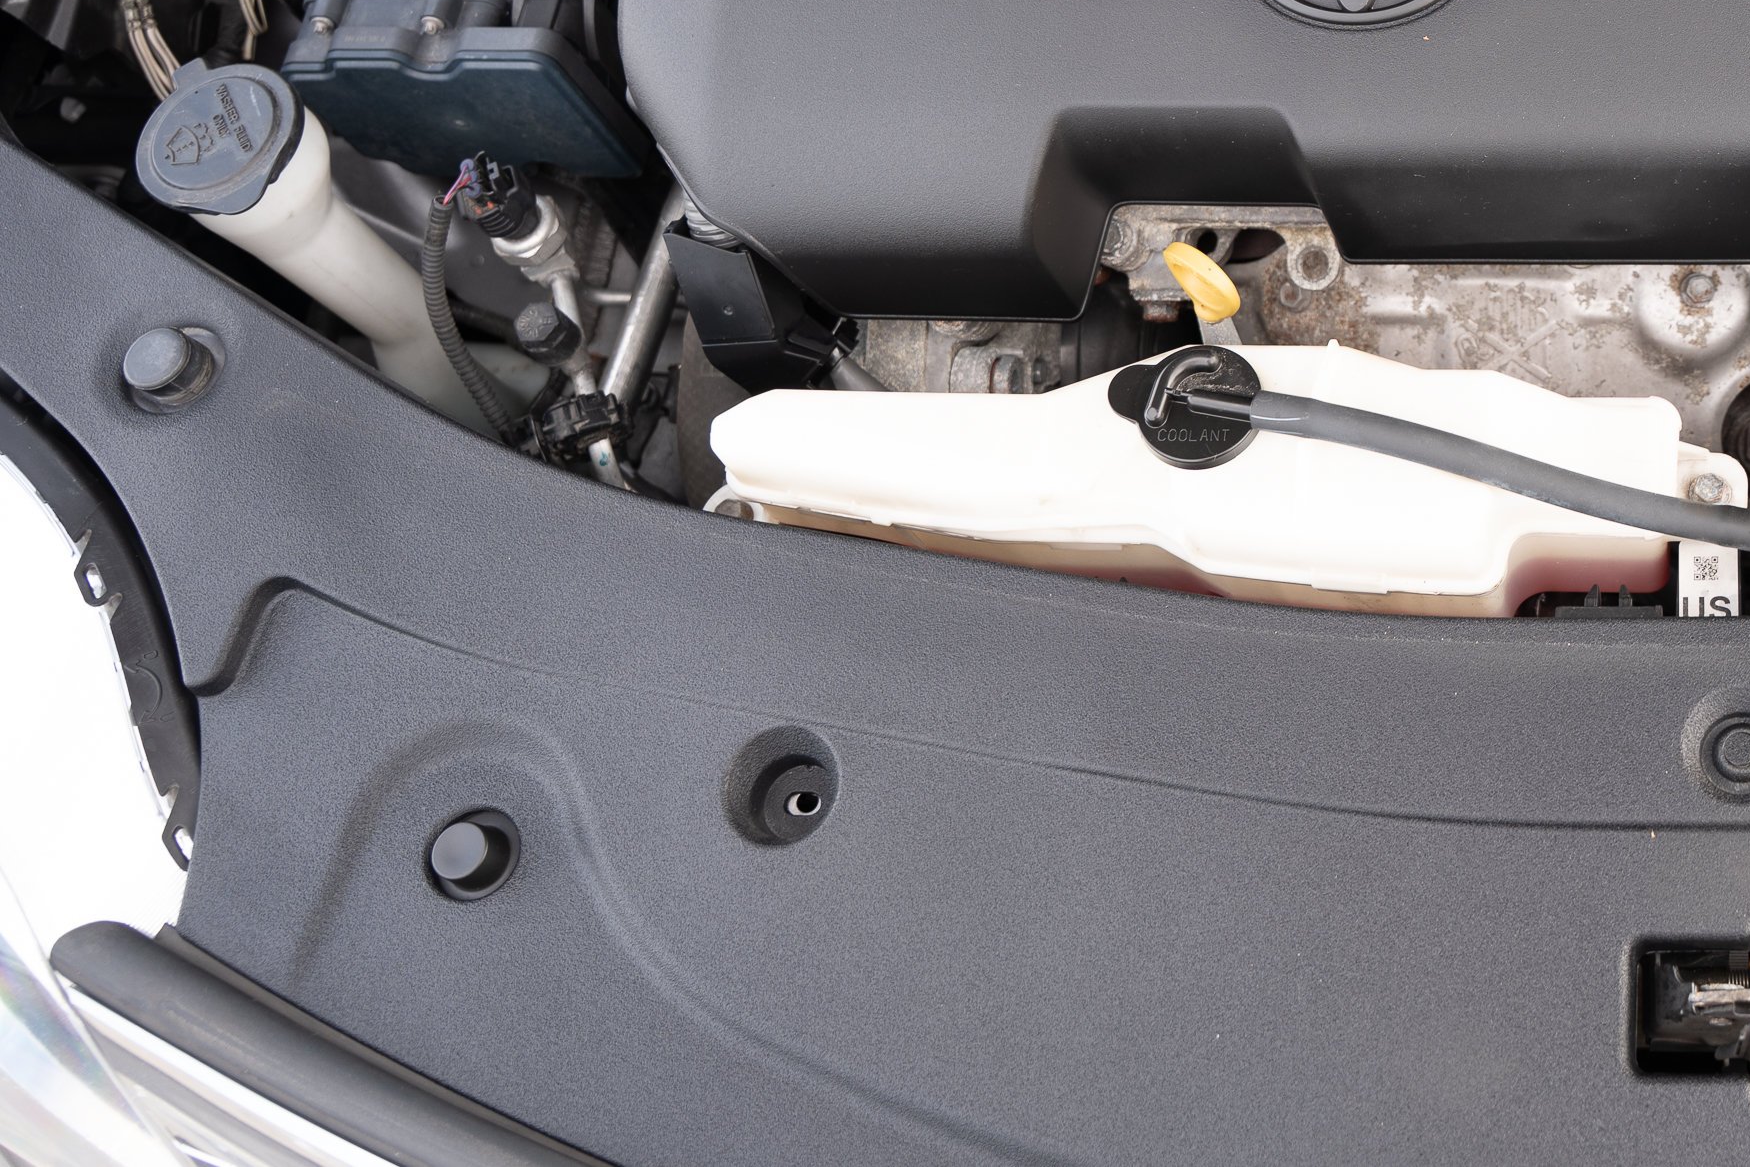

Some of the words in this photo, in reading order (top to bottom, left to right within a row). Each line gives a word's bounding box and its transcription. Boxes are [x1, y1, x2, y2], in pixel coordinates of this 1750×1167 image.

[212, 114, 231, 138] ONLY
[215, 83, 239, 125] WASHER
[233, 124, 254, 153] FLUID
[1157, 428, 1230, 442] COOLANT
